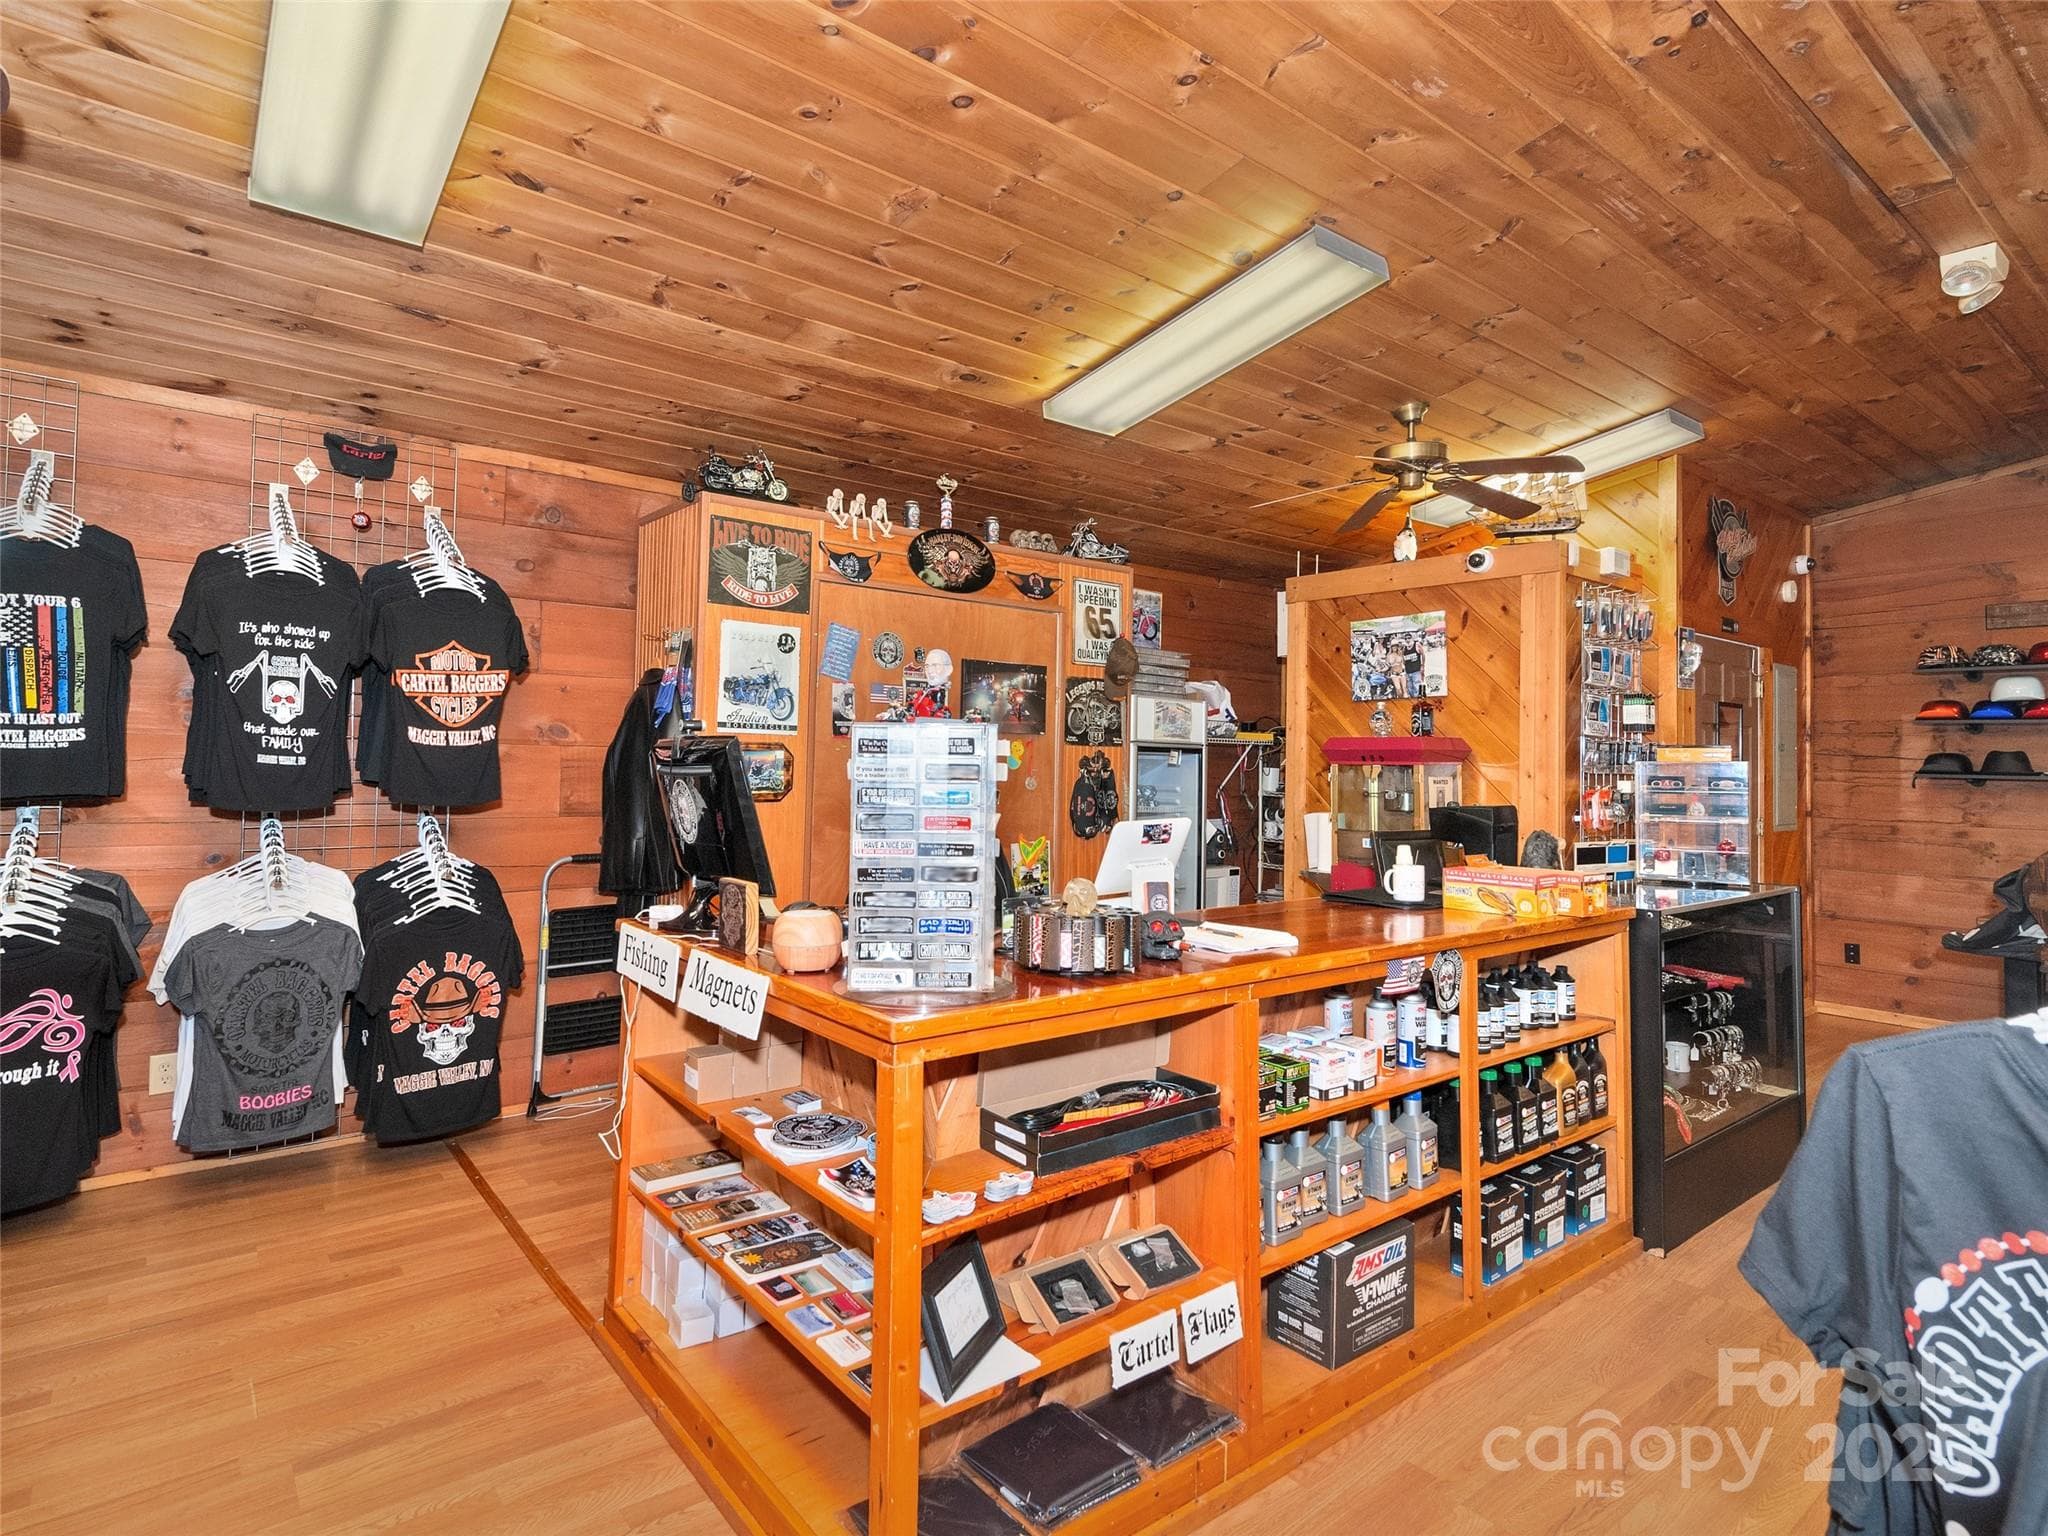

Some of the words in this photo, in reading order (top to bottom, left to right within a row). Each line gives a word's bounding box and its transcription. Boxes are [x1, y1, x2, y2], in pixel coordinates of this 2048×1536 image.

[713, 520, 749, 550] LIVE
[751, 525, 772, 545] TO
[774, 528, 809, 566] RIDE
[23, 594, 67, 608] YOUR
[71, 597, 81, 608] 6
[726, 579, 752, 602] RIDE
[754, 594, 768, 604] TO
[769, 588, 793, 603] LIVE
[1079, 593, 1117, 608] SPEEDING
[1084, 585, 1117, 598] WASN'T
[238, 622, 257, 634] It's
[261, 622, 280, 635] who
[283, 623, 316, 638] showed
[318, 630, 331, 642] up
[1084, 605, 1116, 639] 65
[274, 635, 292, 648] the
[1091, 641, 1108, 650] WAS
[8, 648, 16, 668] EMS
[57, 651, 67, 680] POLICE
[430, 650, 477, 671] MOTOR
[24, 649, 35, 691] DISPATCH
[75, 651, 85, 688] MILITARY
[401, 673, 449, 693] CARTEL
[450, 674, 506, 693] BAGGERS
[1066, 681, 1095, 703] LEGENDS
[13, 713, 28, 725] IN
[29, 713, 57, 725] LAST
[58, 713, 82, 724] OUT
[430, 696, 478, 722] CYCLES
[726, 708, 769, 724] Indian
[28, 728, 86, 743] BAGGERS
[243, 722, 267, 735] that
[270, 724, 298, 736] made
[407, 726, 447, 746] MAGGIE
[481, 724, 496, 742] NC
[623, 933, 668, 988] Fishing
[389, 960, 436, 1034] CARTEL
[444, 952, 501, 1018] BAGGERS
[688, 957, 759, 1016] Magnets
[45, 1059, 60, 1076] it
[239, 1084, 313, 1110] BOOBIES
[221, 1109, 266, 1132] MAGGIE
[1352, 1241, 1403, 1281] AMSOIL
[1360, 1268, 1401, 1304] V-TWIN
[1352, 1306, 1365, 1317] OIL
[1365, 1290, 1396, 1310] CHANGE
[1396, 1283, 1408, 1295] KIT
[1118, 1323, 1174, 1372] Cartel
[1187, 1303, 1236, 1346] Flags
